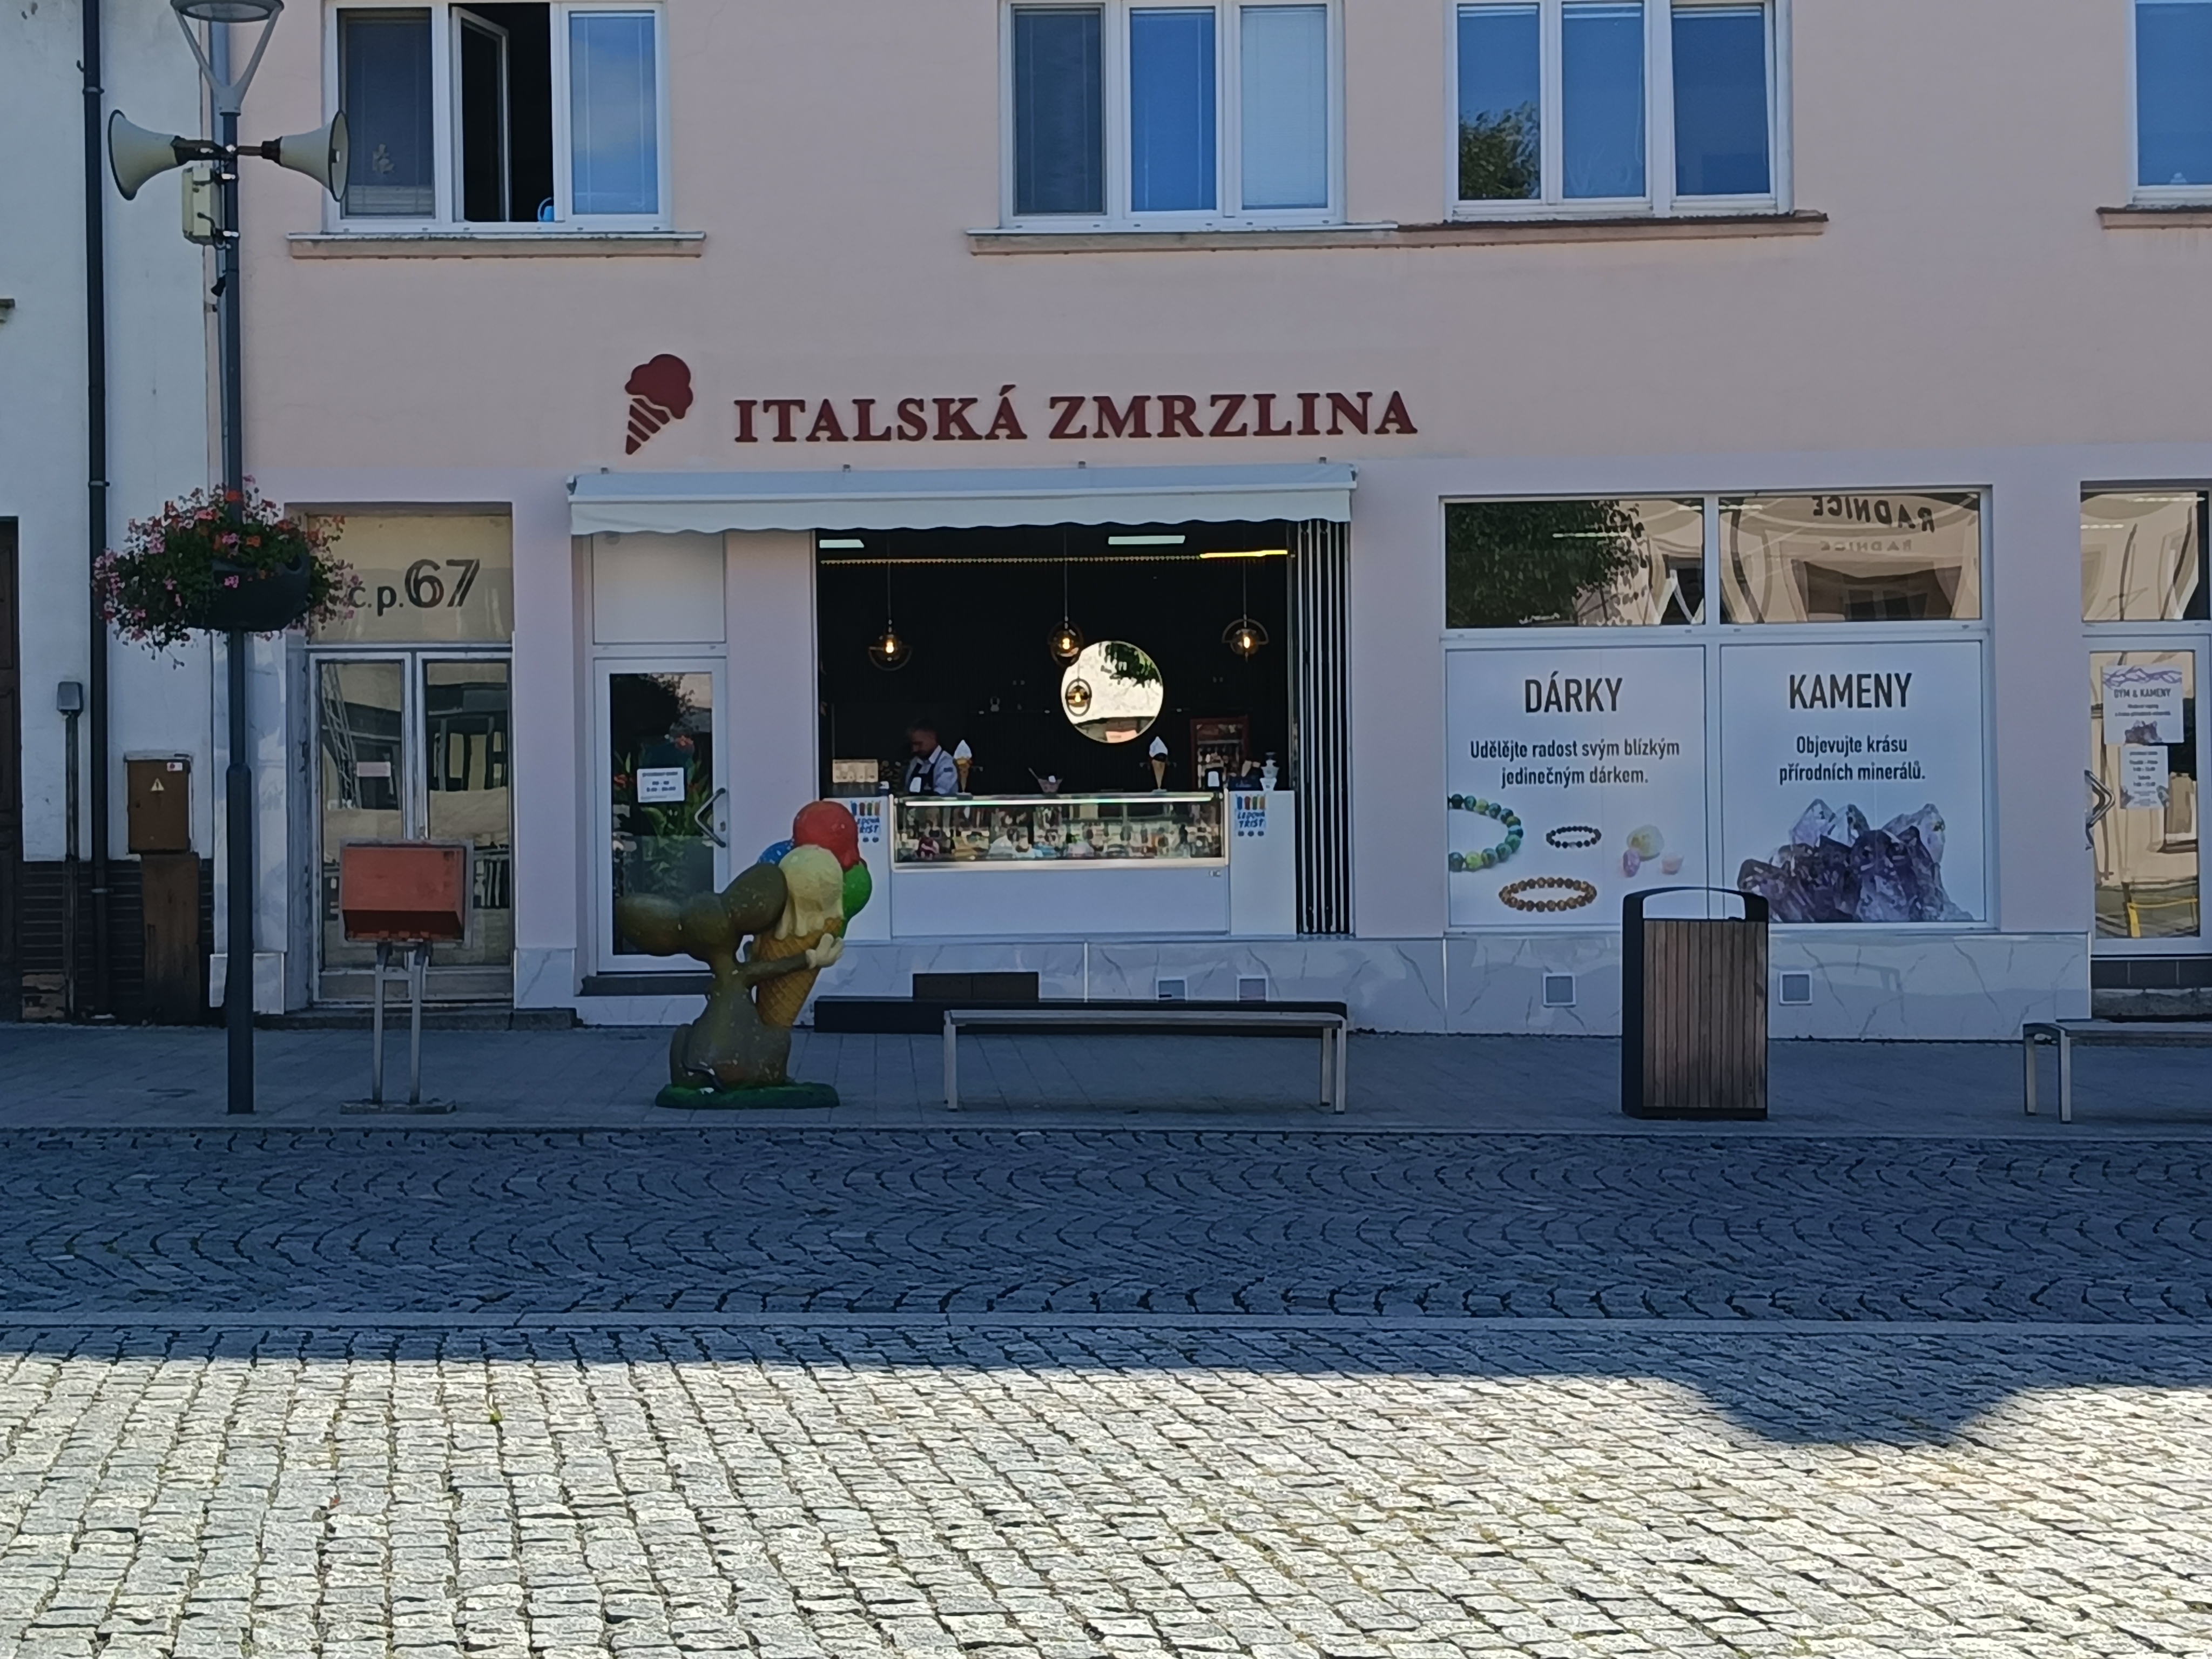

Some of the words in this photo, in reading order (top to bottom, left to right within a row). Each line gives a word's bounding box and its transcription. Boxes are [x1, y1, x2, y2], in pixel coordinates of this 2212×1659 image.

[734, 384, 1028, 442] ITALSKÁ
[1049, 390, 1418, 440] ZMRZLINA
[1525, 670, 1623, 713] DÁRKY
[1790, 672, 1912, 709] KAMENY
[1471, 740, 1528, 762] Udělějte
[1533, 740, 1577, 757] radost
[1582, 739, 1620, 760] svým
[1624, 738, 1680, 760] blízkým
[1797, 736, 1862, 757] Objevujte
[1867, 735, 1907, 753] krásu
[1501, 767, 1584, 789] jedinečným
[1589, 766, 1649, 784] dárkem.
[1779, 763, 1853, 785] přírodních
[1858, 761, 1926, 780] minerálů.
